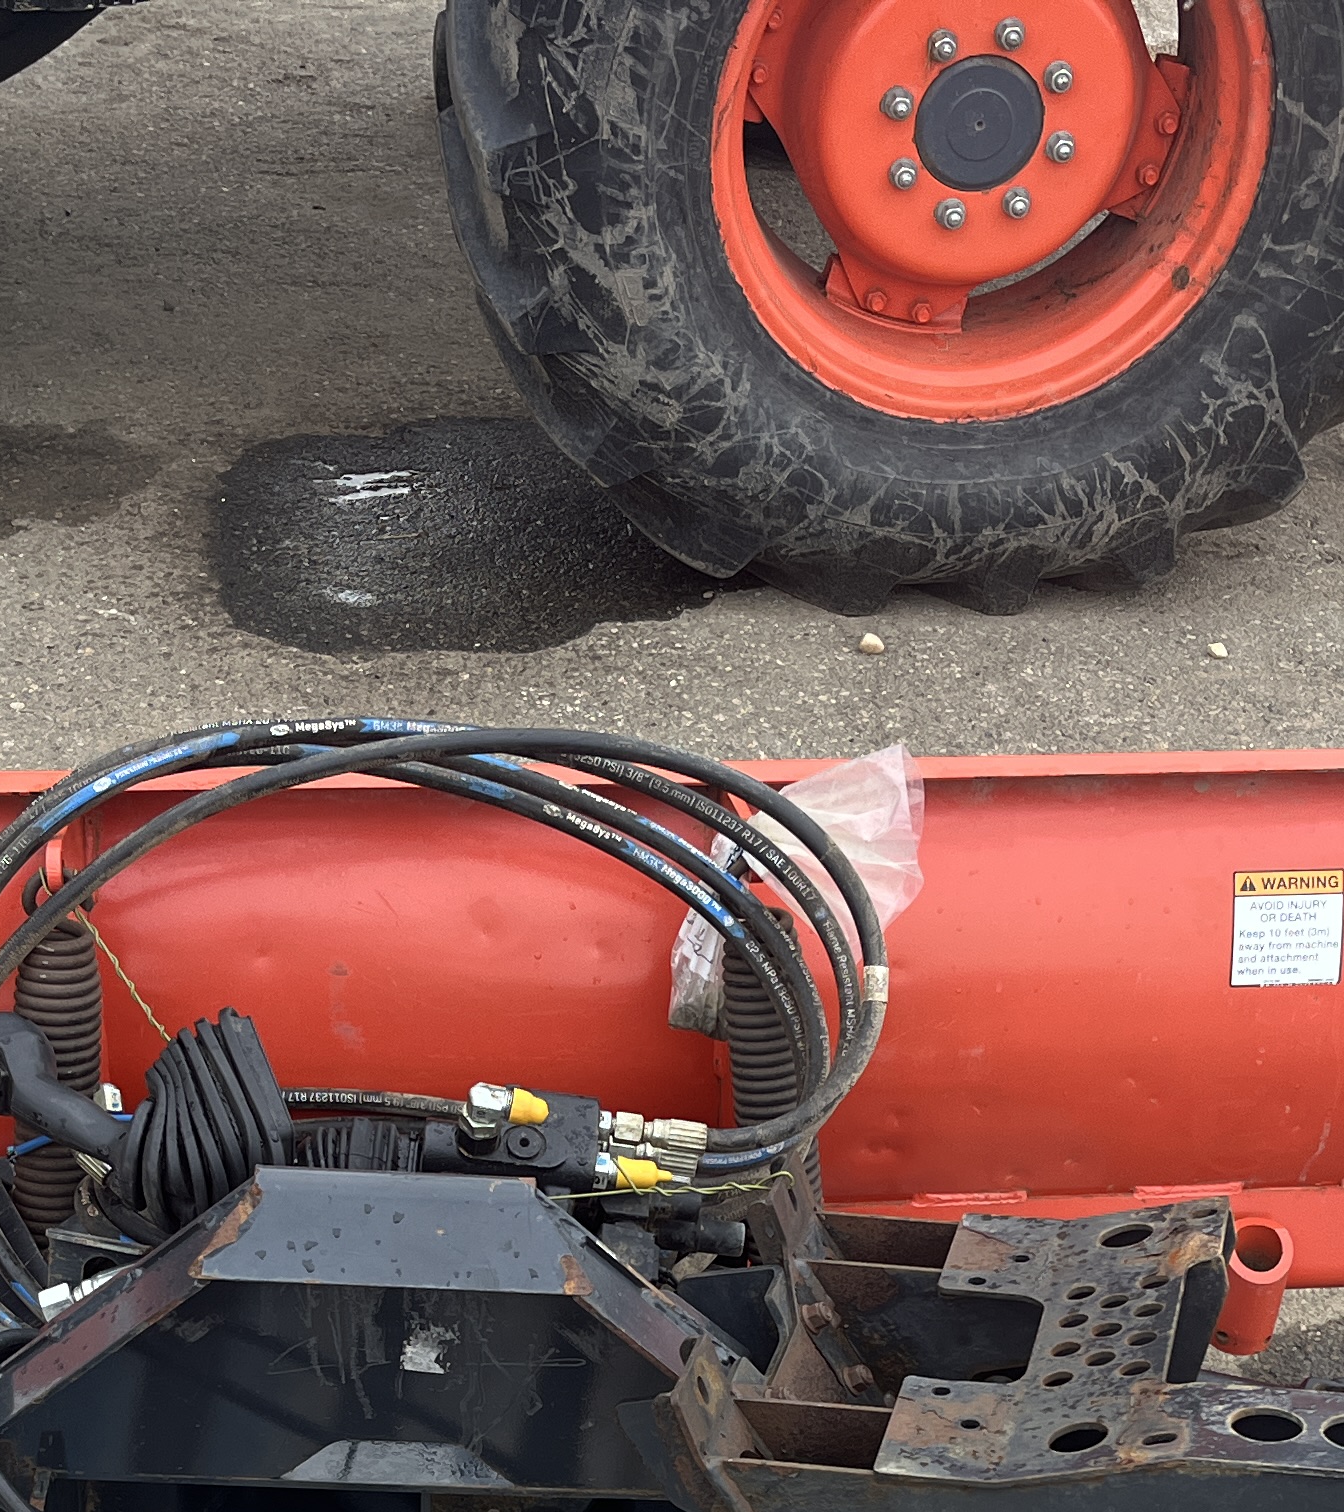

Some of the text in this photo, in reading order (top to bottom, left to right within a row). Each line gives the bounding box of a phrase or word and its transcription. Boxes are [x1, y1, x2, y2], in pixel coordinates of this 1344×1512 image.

[693, 798, 745, 835] ISO11237
[741, 828, 763, 848] R17
[764, 847, 788, 869] SAE
[1261, 875, 1340, 891] WARNING
[1249, 899, 1327, 911] AVOID INJURY
[1260, 912, 1317, 923] OR DEATH
[1239, 927, 1330, 939] Keep 10 feet (3m)
[1238, 940, 1339, 952] away from machine
[822, 919, 845, 956] Flame
[835, 952, 857, 1008] Resistant
[1237, 953, 1319, 964] and attachment
[761, 961, 779, 985] MPa
[1237, 967, 1264, 976] when
[1267, 966, 1277, 975] in
[287, 1091, 308, 1102] R17
[309, 1091, 357, 1103] ISO11237
